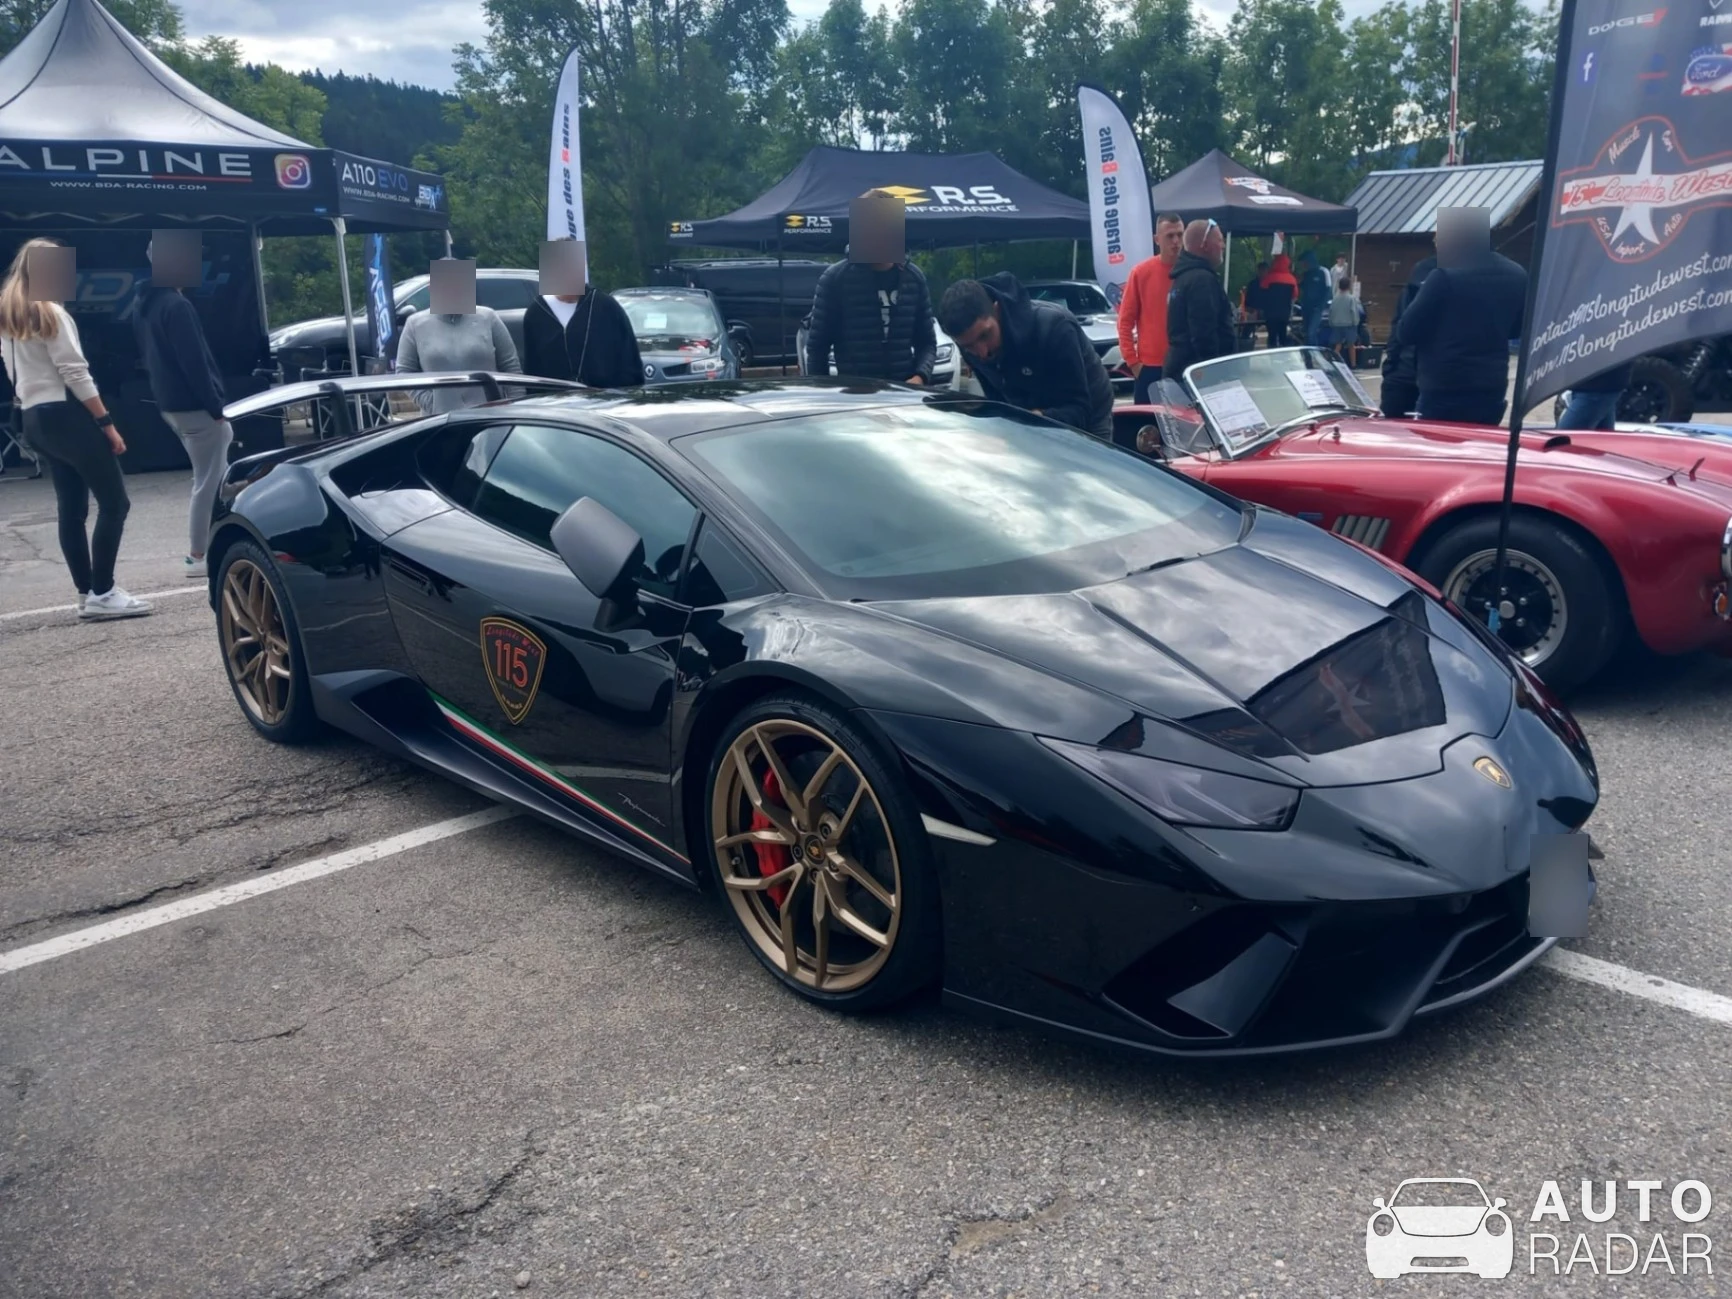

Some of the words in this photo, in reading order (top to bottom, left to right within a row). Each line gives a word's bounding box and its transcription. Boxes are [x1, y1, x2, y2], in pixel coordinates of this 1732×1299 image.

[561, 104, 570, 164] Bains
[0, 144, 253, 176] ALPINE
[341, 162, 376, 186] A110
[377, 168, 409, 192] EVO
[562, 167, 573, 205] des
[495, 639, 528, 688] 115
